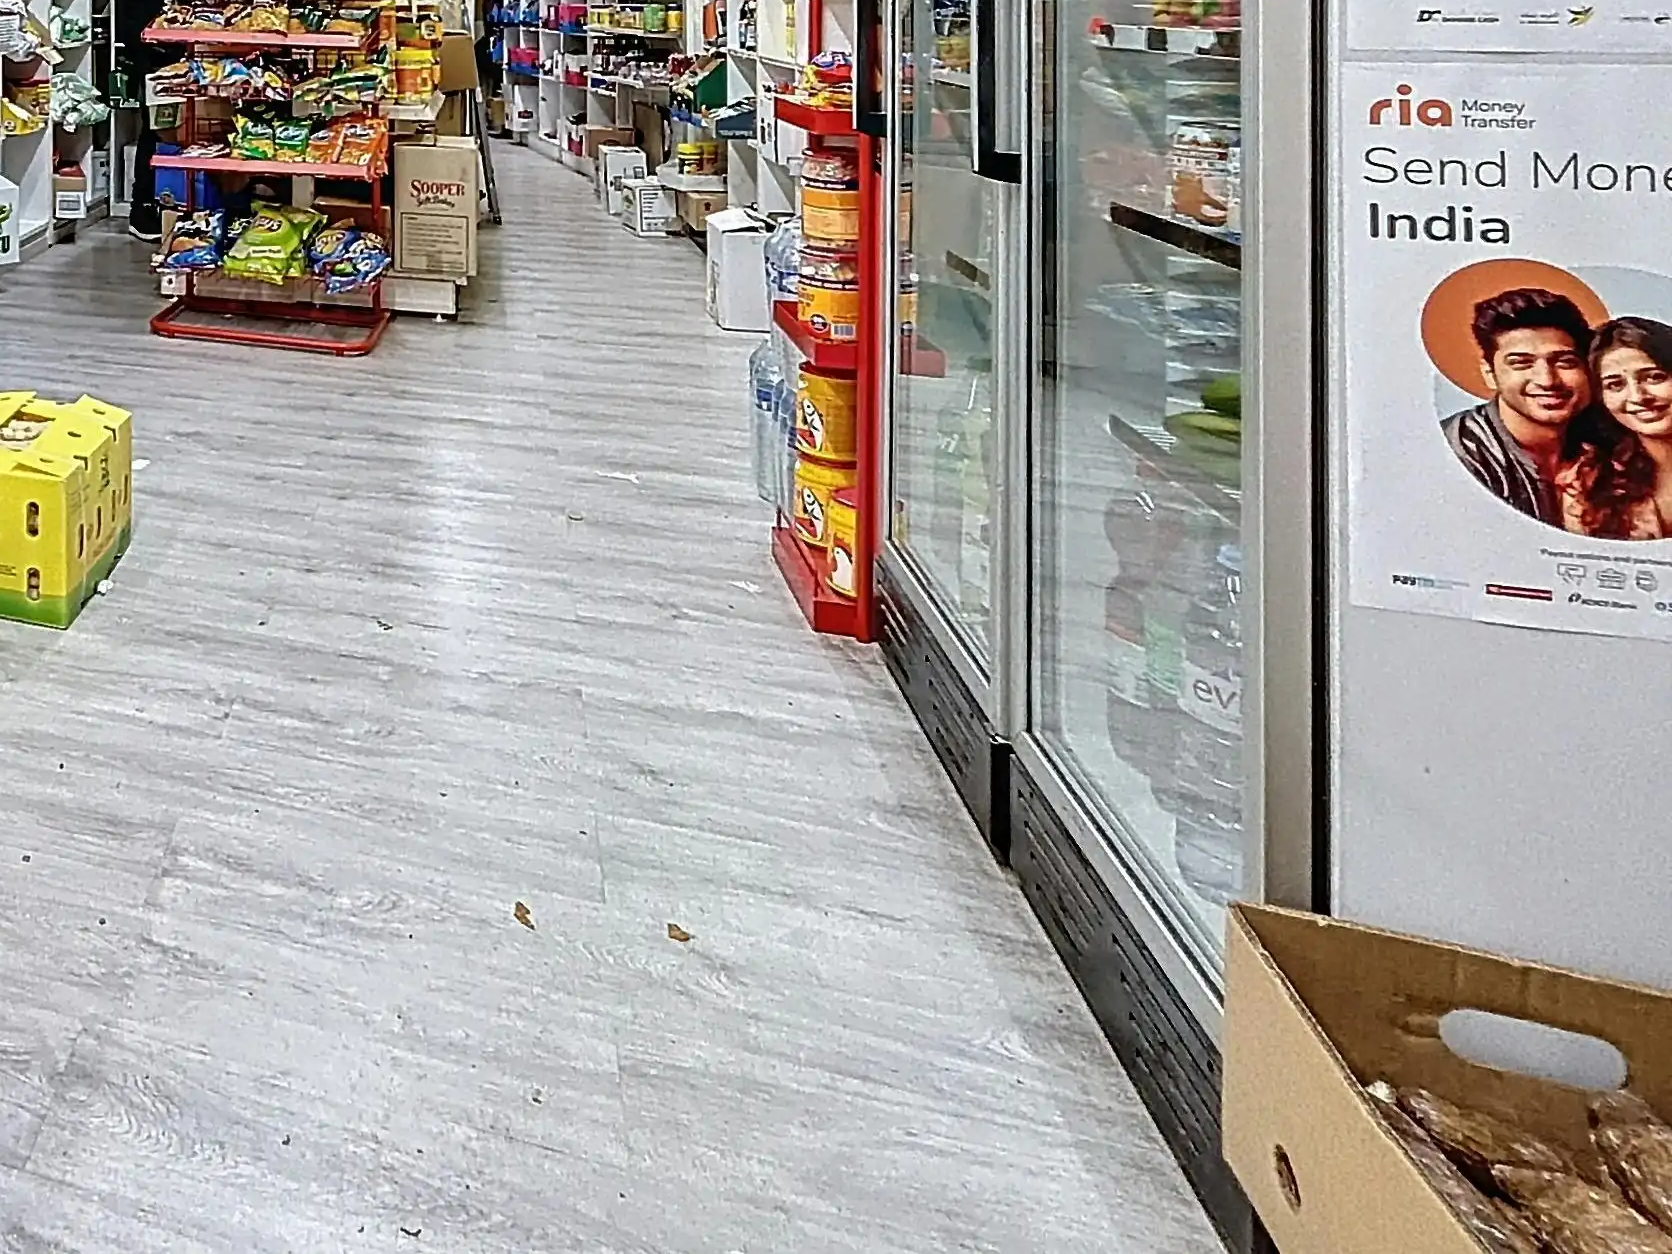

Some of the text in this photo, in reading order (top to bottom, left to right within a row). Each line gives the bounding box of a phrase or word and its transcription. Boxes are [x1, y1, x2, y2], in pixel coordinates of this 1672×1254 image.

[1369, 84, 1453, 127] ria
[1461, 99, 1525, 116] Money
[1461, 114, 1537, 130] Transfer
[1363, 146, 1507, 188] Send
[410, 179, 465, 198] SOOPER
[1369, 202, 1510, 245] India
